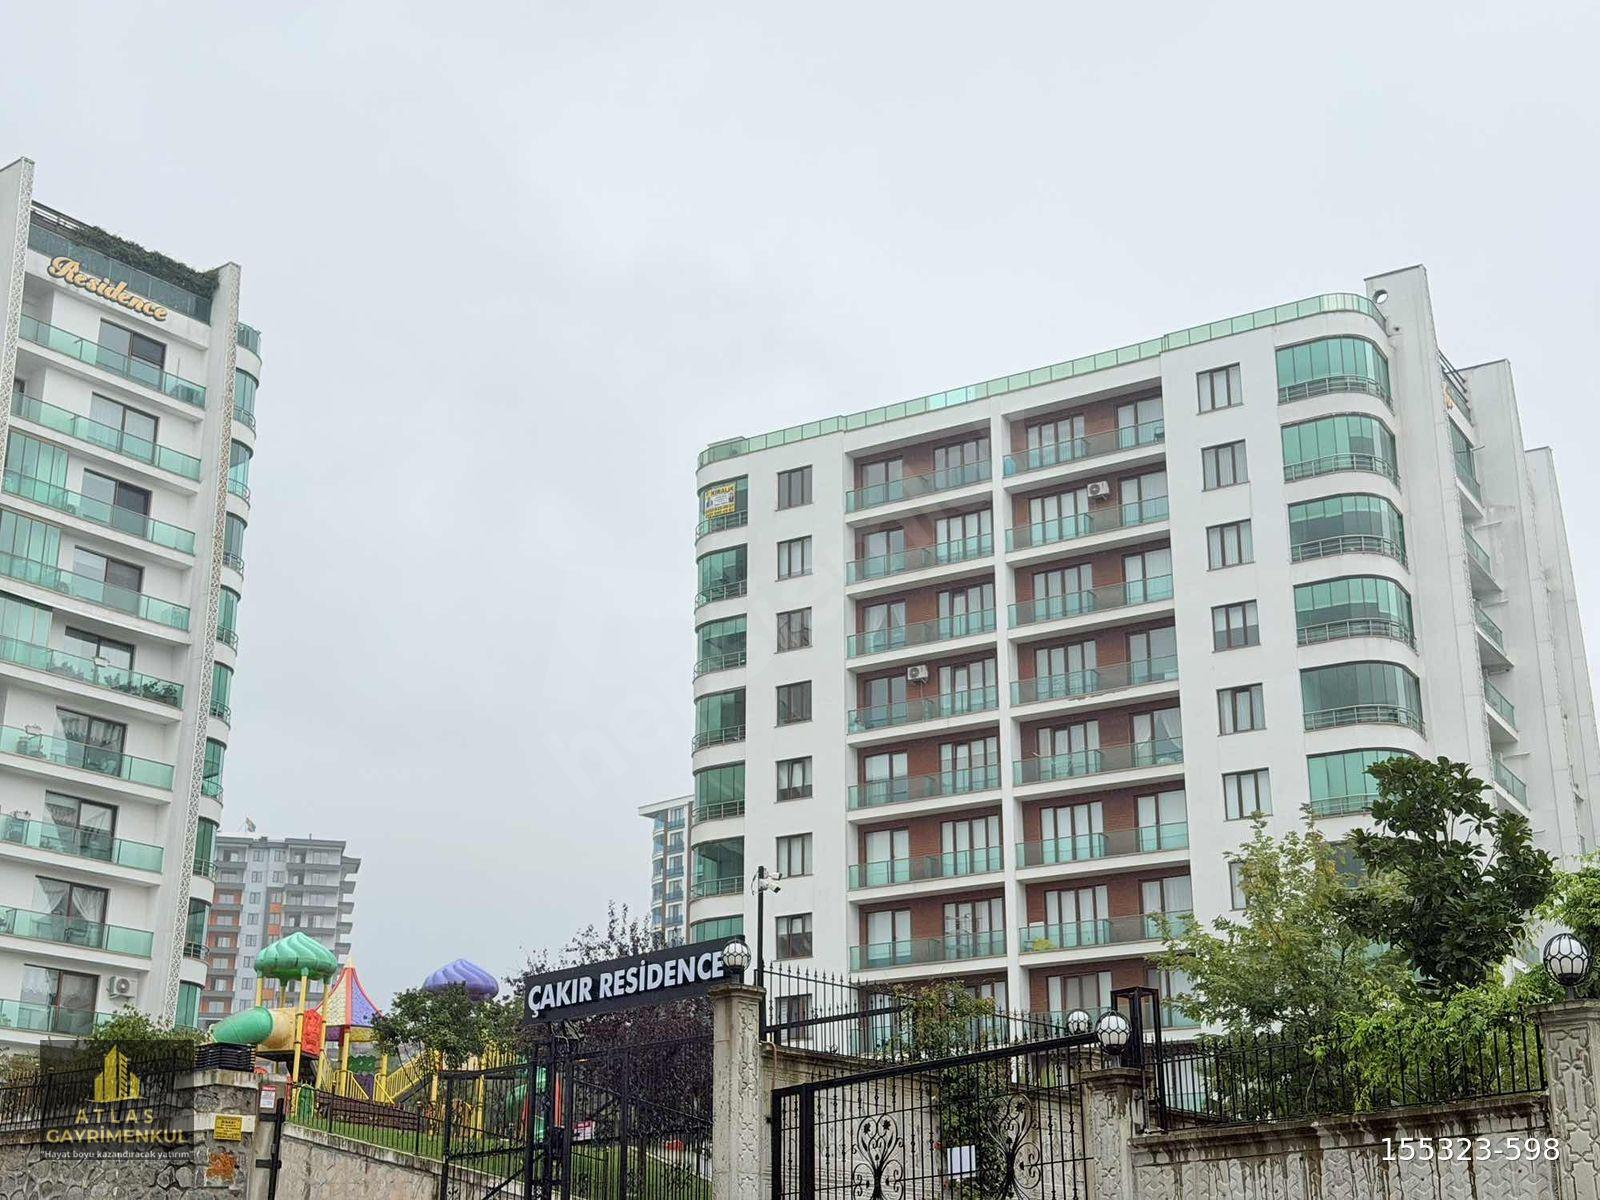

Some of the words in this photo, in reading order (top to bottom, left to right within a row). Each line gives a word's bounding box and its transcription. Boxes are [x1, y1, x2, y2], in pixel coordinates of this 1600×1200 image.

[47, 256, 168, 321] Residence
[527, 976, 593, 1018] ÇAKIR
[598, 951, 725, 999] RESİDENCE
